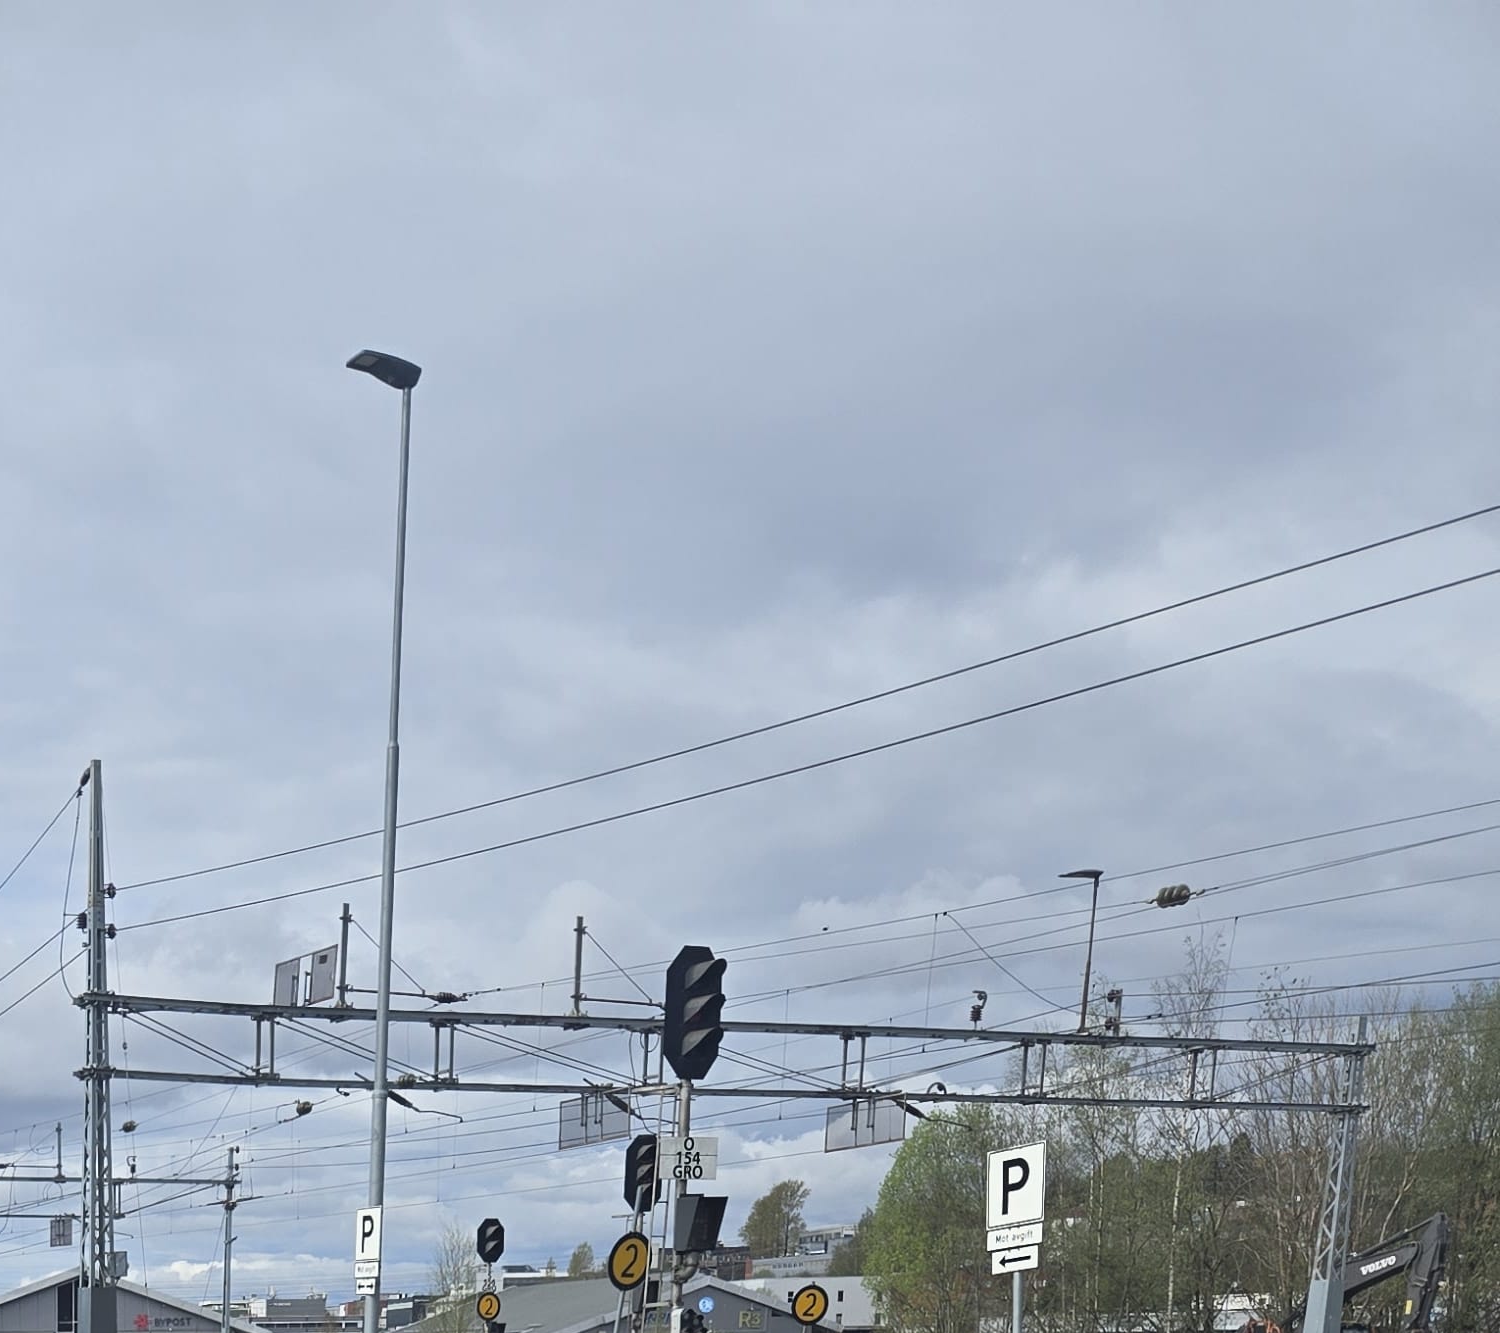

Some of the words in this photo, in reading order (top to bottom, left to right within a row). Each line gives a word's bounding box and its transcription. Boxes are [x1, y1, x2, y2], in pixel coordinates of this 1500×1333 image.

[676, 1151, 701, 1165] 154
[672, 1165, 703, 1179] GRO
[1002, 1157, 1030, 1215] P
[361, 1215, 374, 1253] P
[621, 1243, 638, 1278] 2
[1360, 1255, 1396, 1275] VOLVO
[484, 1297, 493, 1316] 2
[803, 1292, 817, 1317] 2
